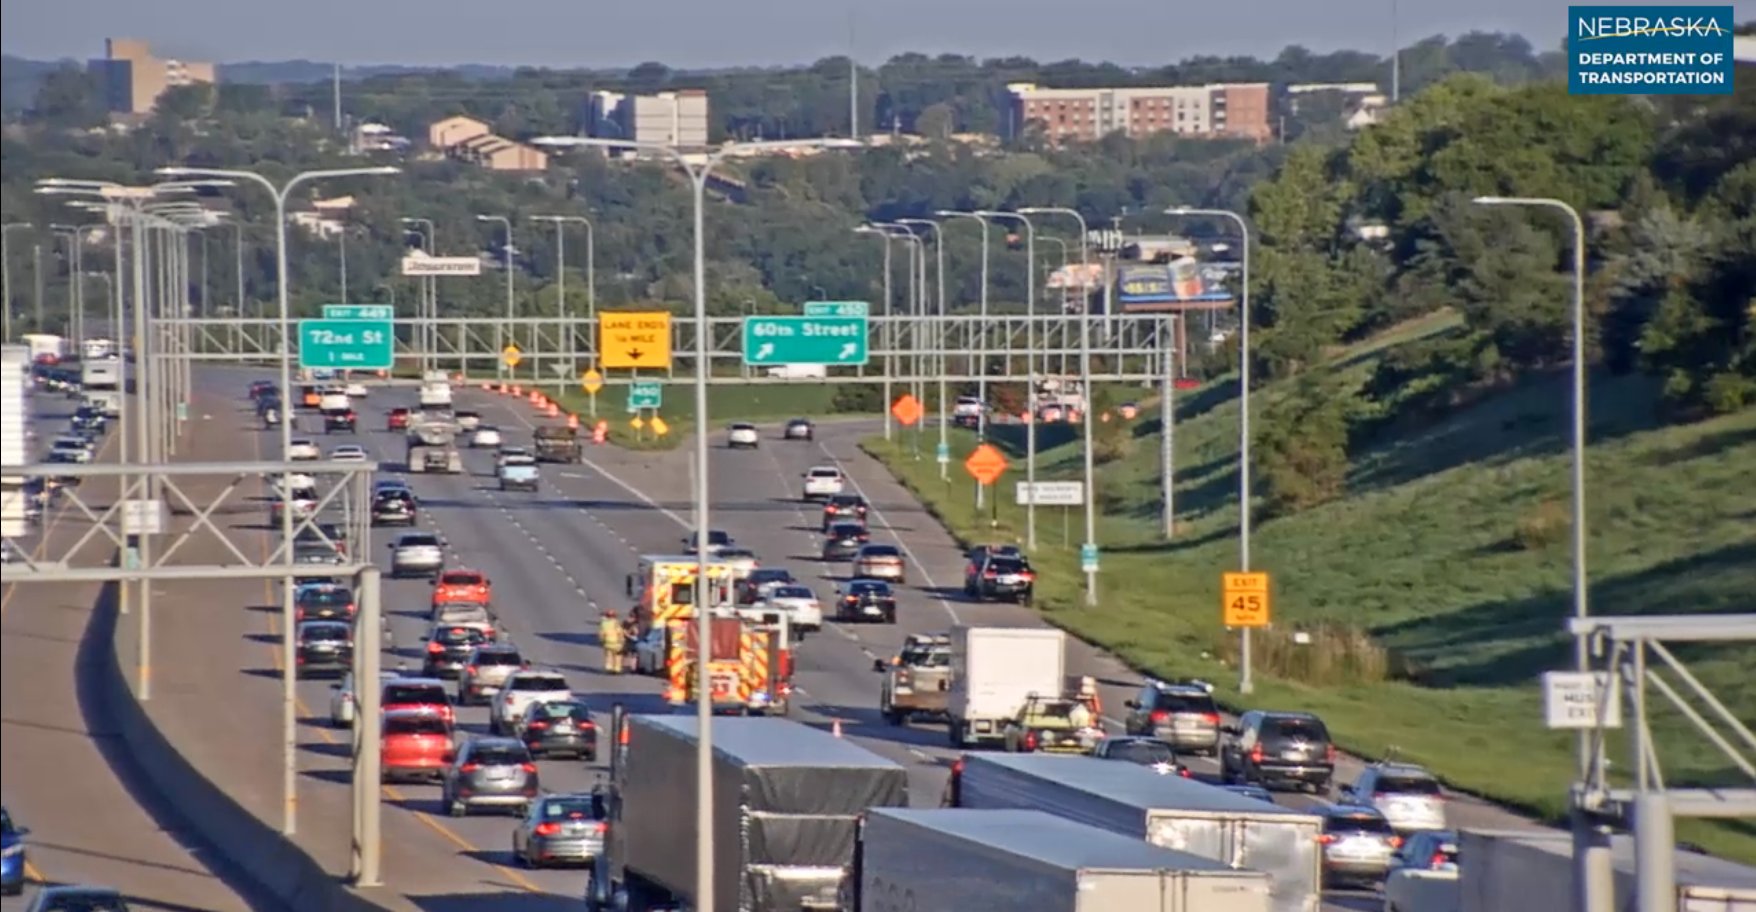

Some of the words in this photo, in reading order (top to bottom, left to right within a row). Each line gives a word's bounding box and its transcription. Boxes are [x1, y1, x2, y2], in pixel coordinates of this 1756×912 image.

[604, 321, 632, 330] LANE
[637, 321, 666, 330] ENDS
[753, 322, 794, 337] 60th
[801, 322, 859, 337] Street
[309, 329, 353, 345] 72nd
[362, 329, 383, 345] St
[630, 334, 655, 343] MILE
[1233, 577, 1257, 587] EXIT
[1231, 595, 1261, 612] 45
[1564, 693, 1595, 703] MUS
